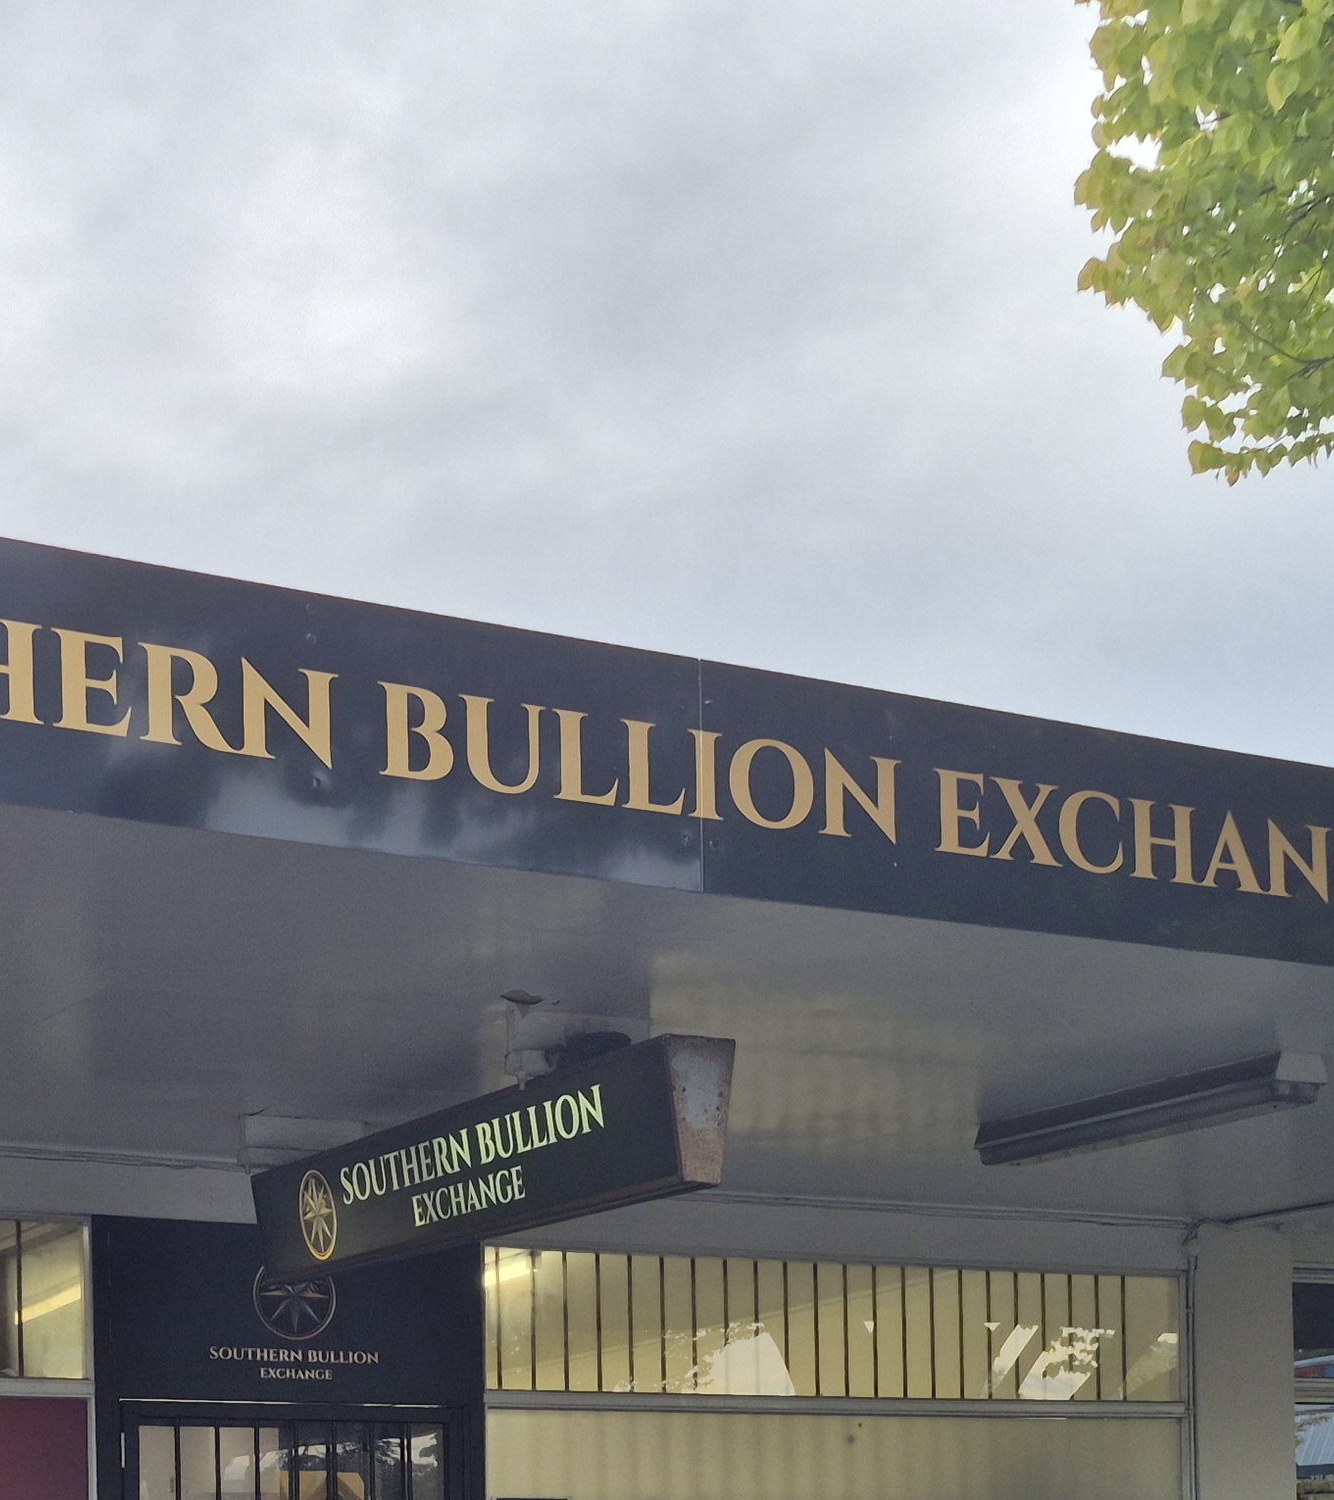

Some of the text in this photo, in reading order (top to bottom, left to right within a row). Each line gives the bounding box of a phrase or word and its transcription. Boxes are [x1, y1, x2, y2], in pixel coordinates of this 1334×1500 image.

[377, 681, 902, 844] BULLION
[340, 1084, 605, 1206] SOUTHERN BULLION
[411, 1165, 526, 1228] EXCHANGE
[209, 1345, 380, 1365] SOUTHERN BULLION
[260, 1367, 333, 1381] EXCHANGE
